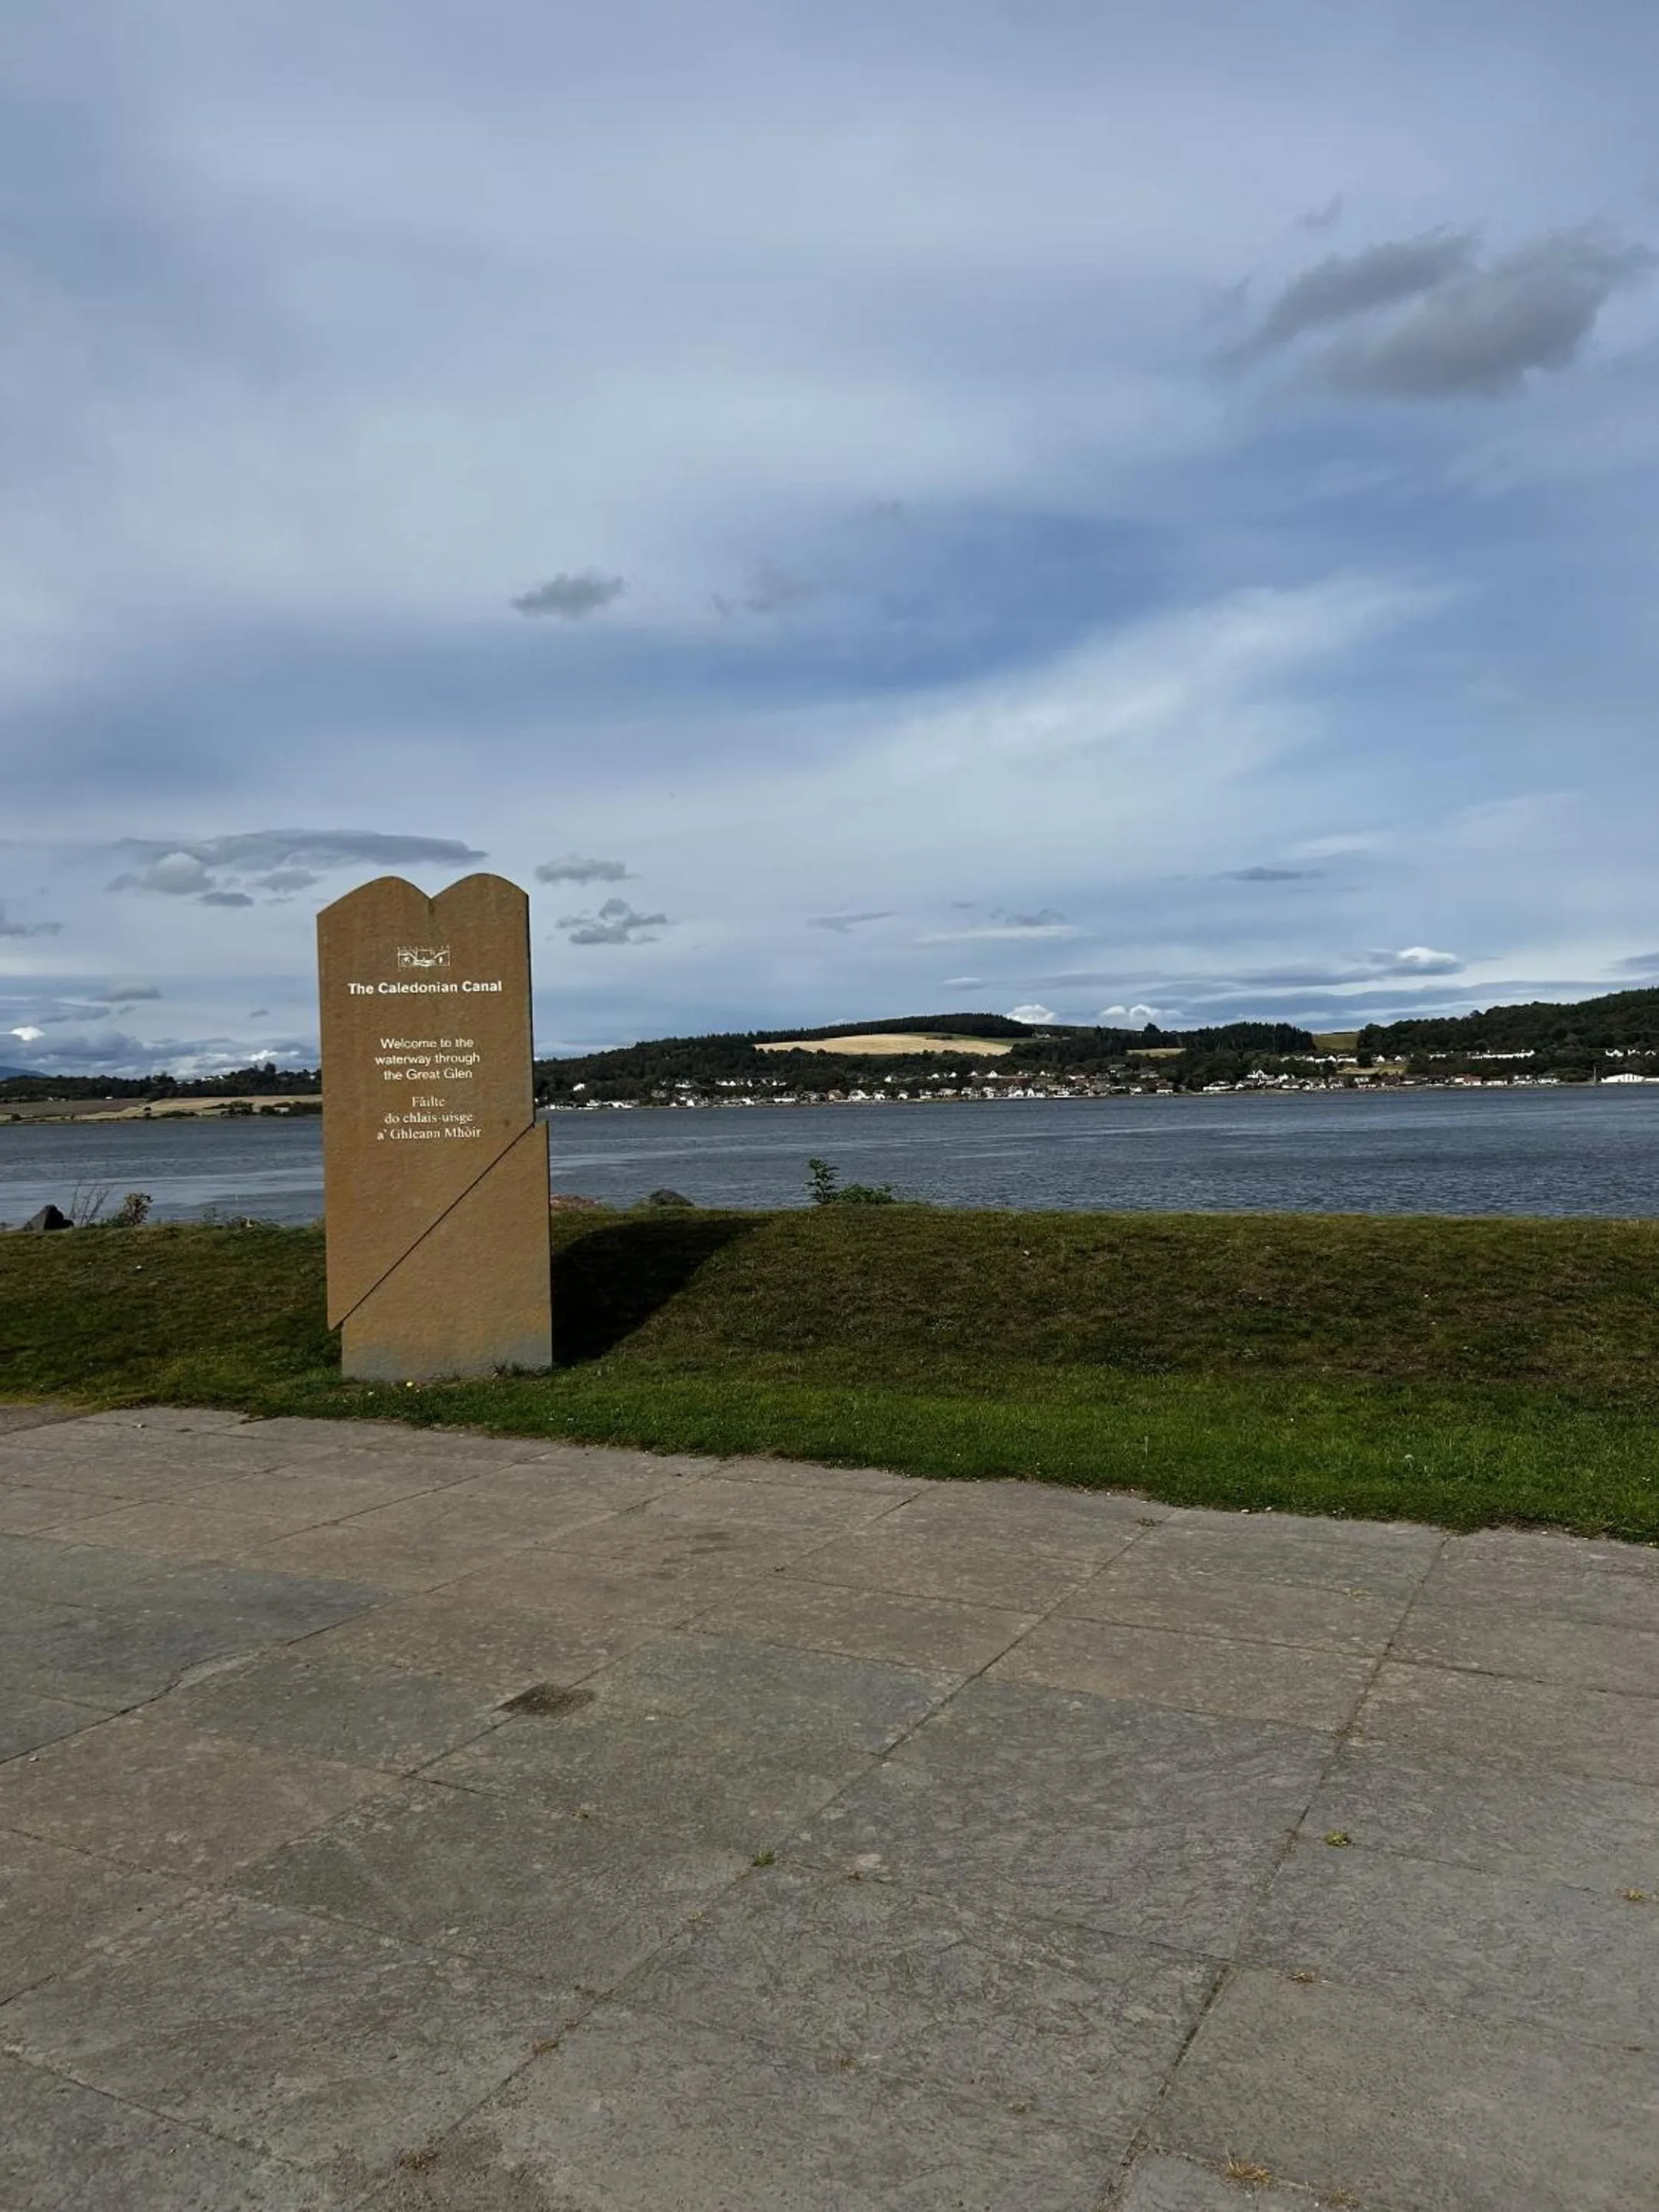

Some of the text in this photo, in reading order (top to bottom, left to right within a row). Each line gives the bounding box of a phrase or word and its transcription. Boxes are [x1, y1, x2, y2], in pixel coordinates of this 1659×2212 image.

[349, 980, 502, 994] The Caledonian Canal
[380, 1037, 474, 1049] Welcome to the
[375, 1053, 480, 1066] waterway through
[384, 1069, 473, 1080] the Great Glen
[385, 1113, 399, 1124] do
[390, 1129, 441, 1139] Ghleann
